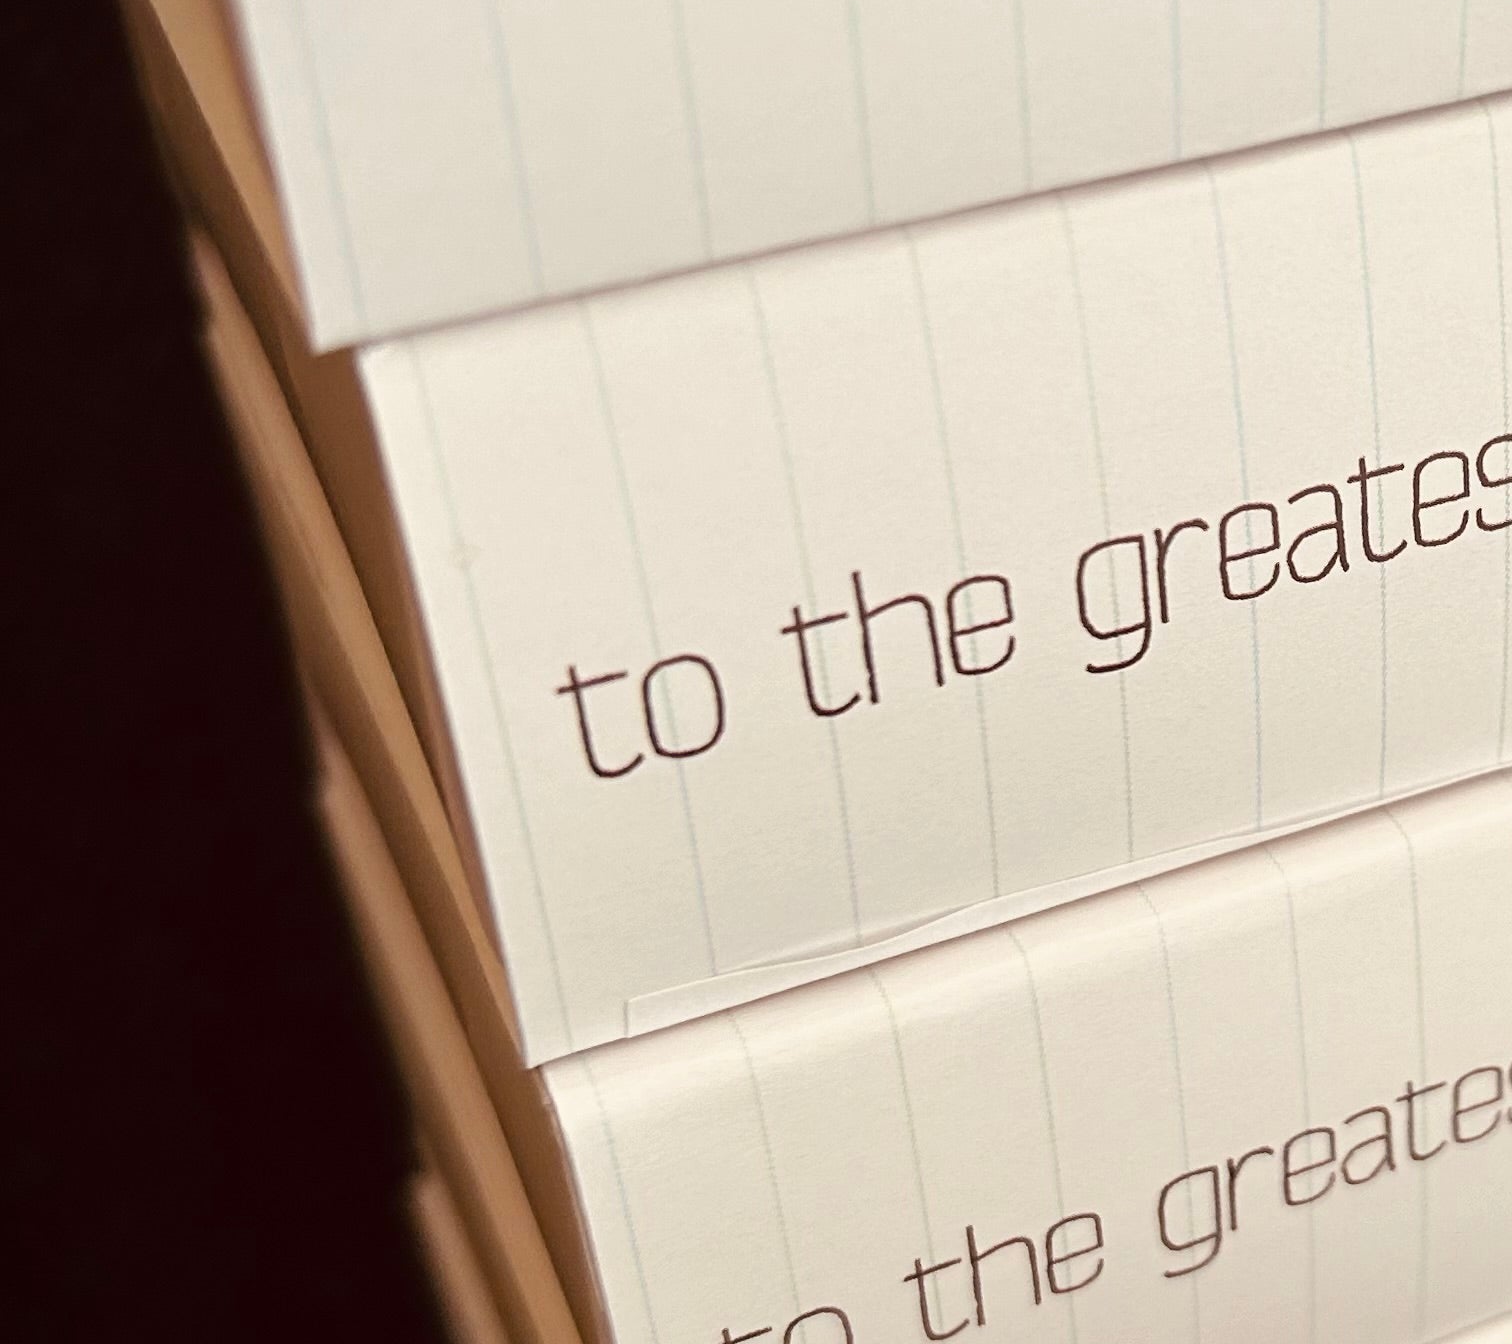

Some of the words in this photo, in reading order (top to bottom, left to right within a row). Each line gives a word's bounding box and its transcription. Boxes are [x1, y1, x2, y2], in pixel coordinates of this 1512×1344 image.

[556, 653, 726, 780] to
[781, 570, 1015, 718] the
[903, 1210, 1104, 1342] the
